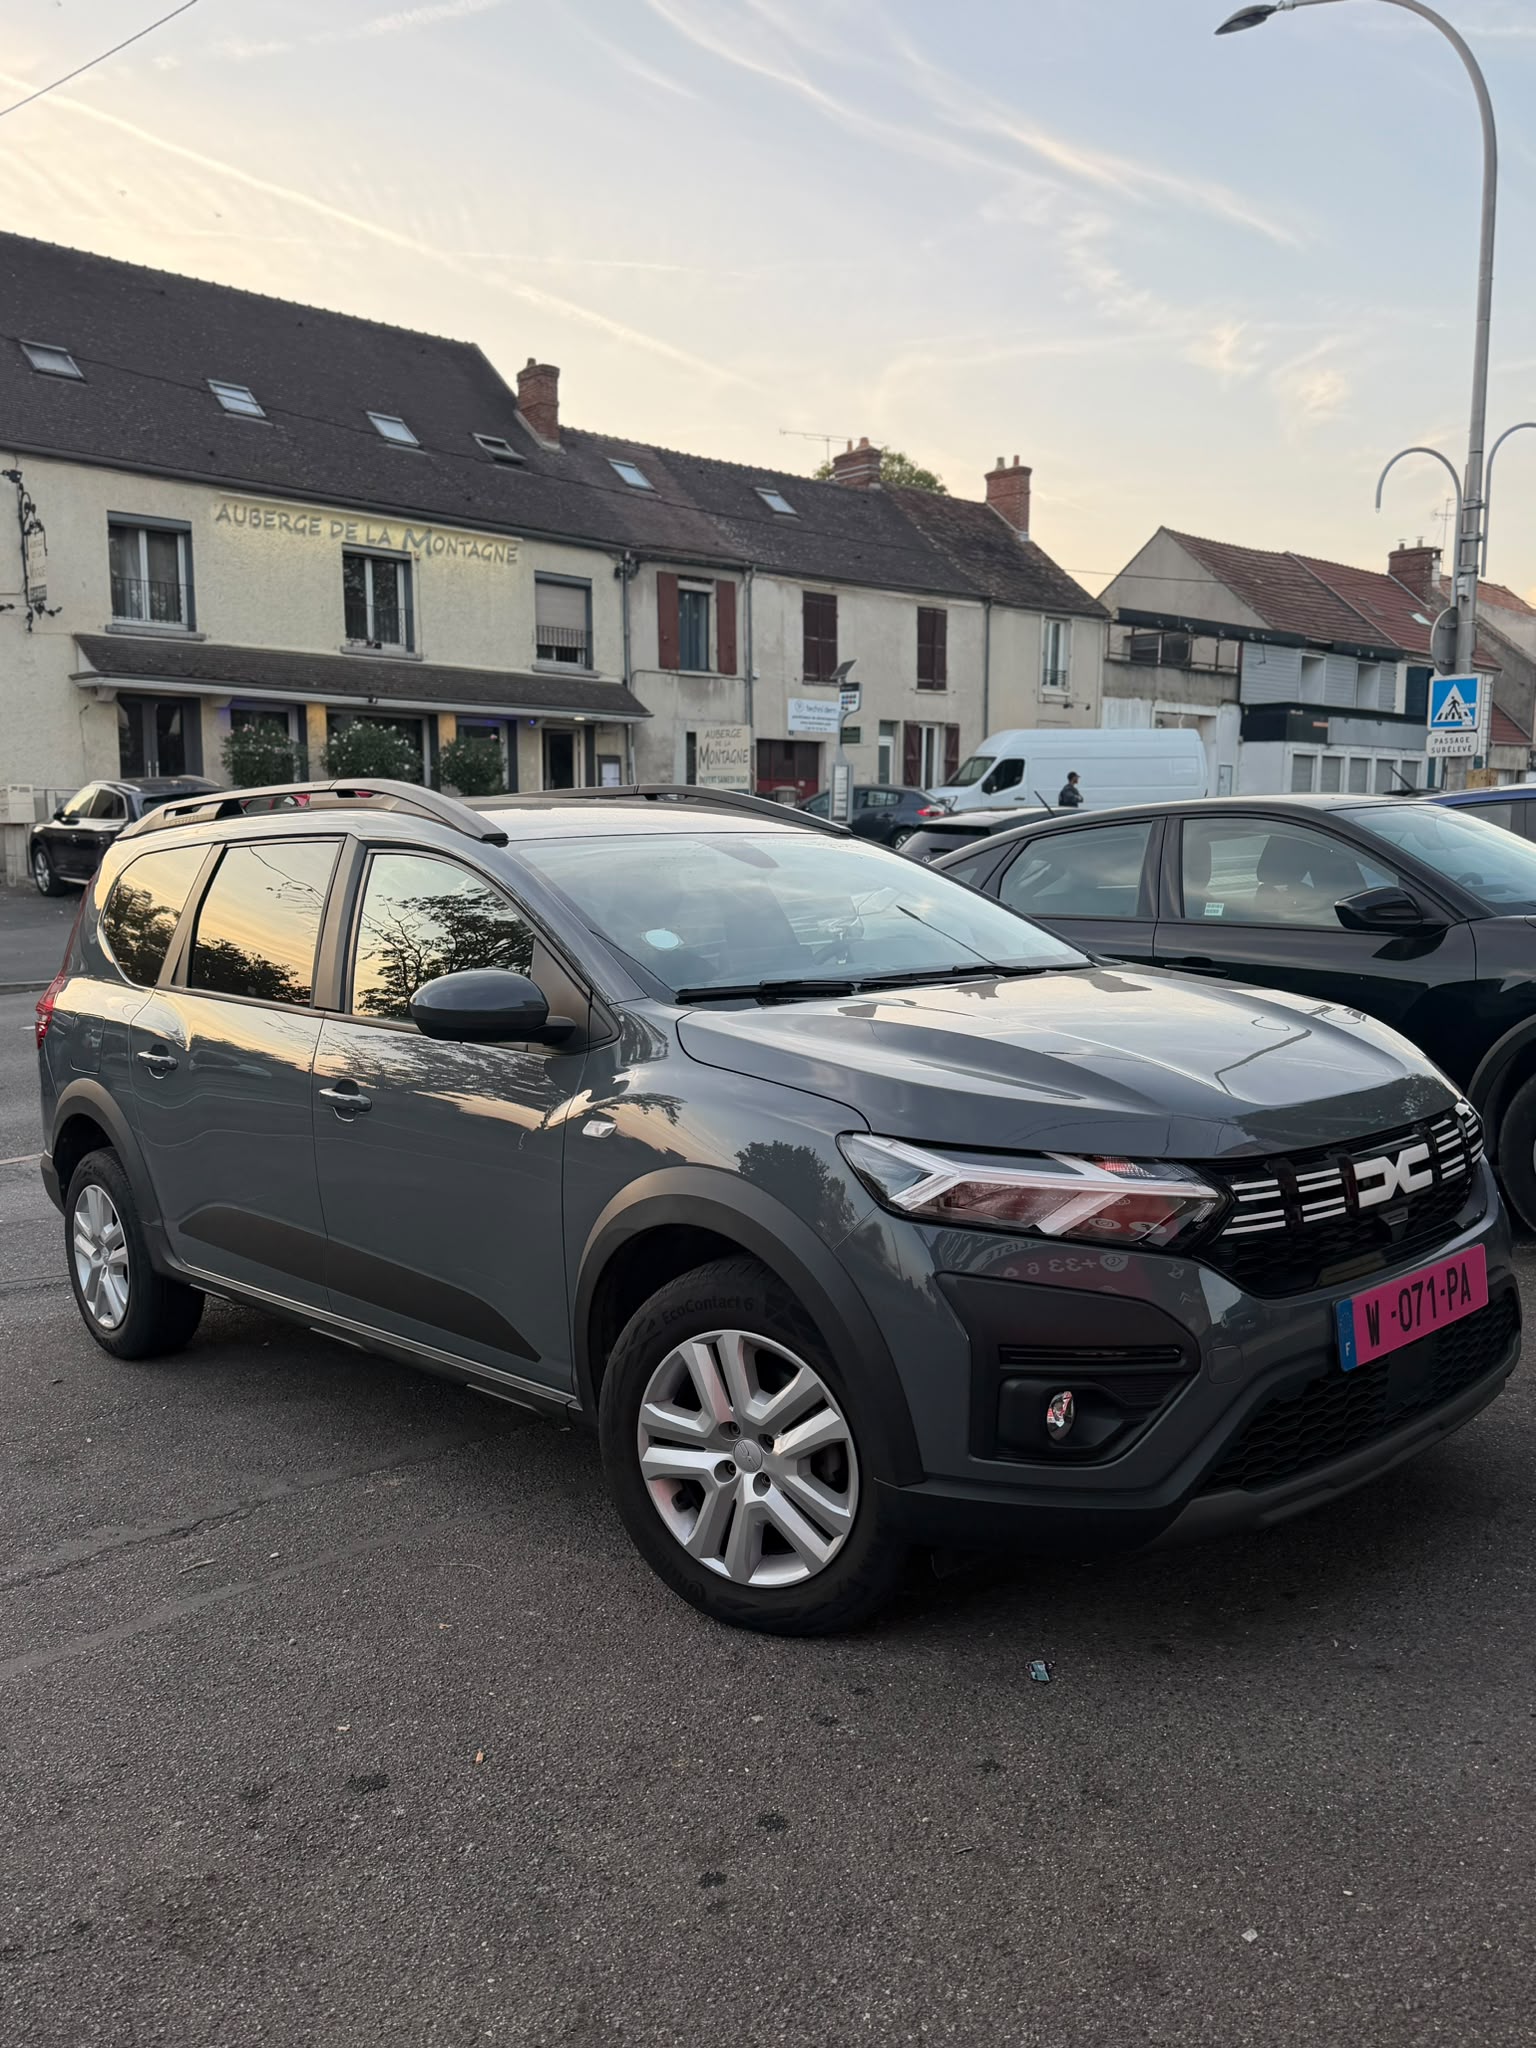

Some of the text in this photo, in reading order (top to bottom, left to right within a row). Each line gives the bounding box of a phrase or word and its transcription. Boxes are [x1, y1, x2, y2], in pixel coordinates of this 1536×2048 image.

[215, 503, 519, 564] AUBERGE DE LA MONTAGNE
[704, 728, 743, 740] AUBERGE
[1434, 736, 1470, 745] PASSAGE
[662, 1296, 754, 1325] EcoContact 6
[1345, 1341, 1352, 1357] F
